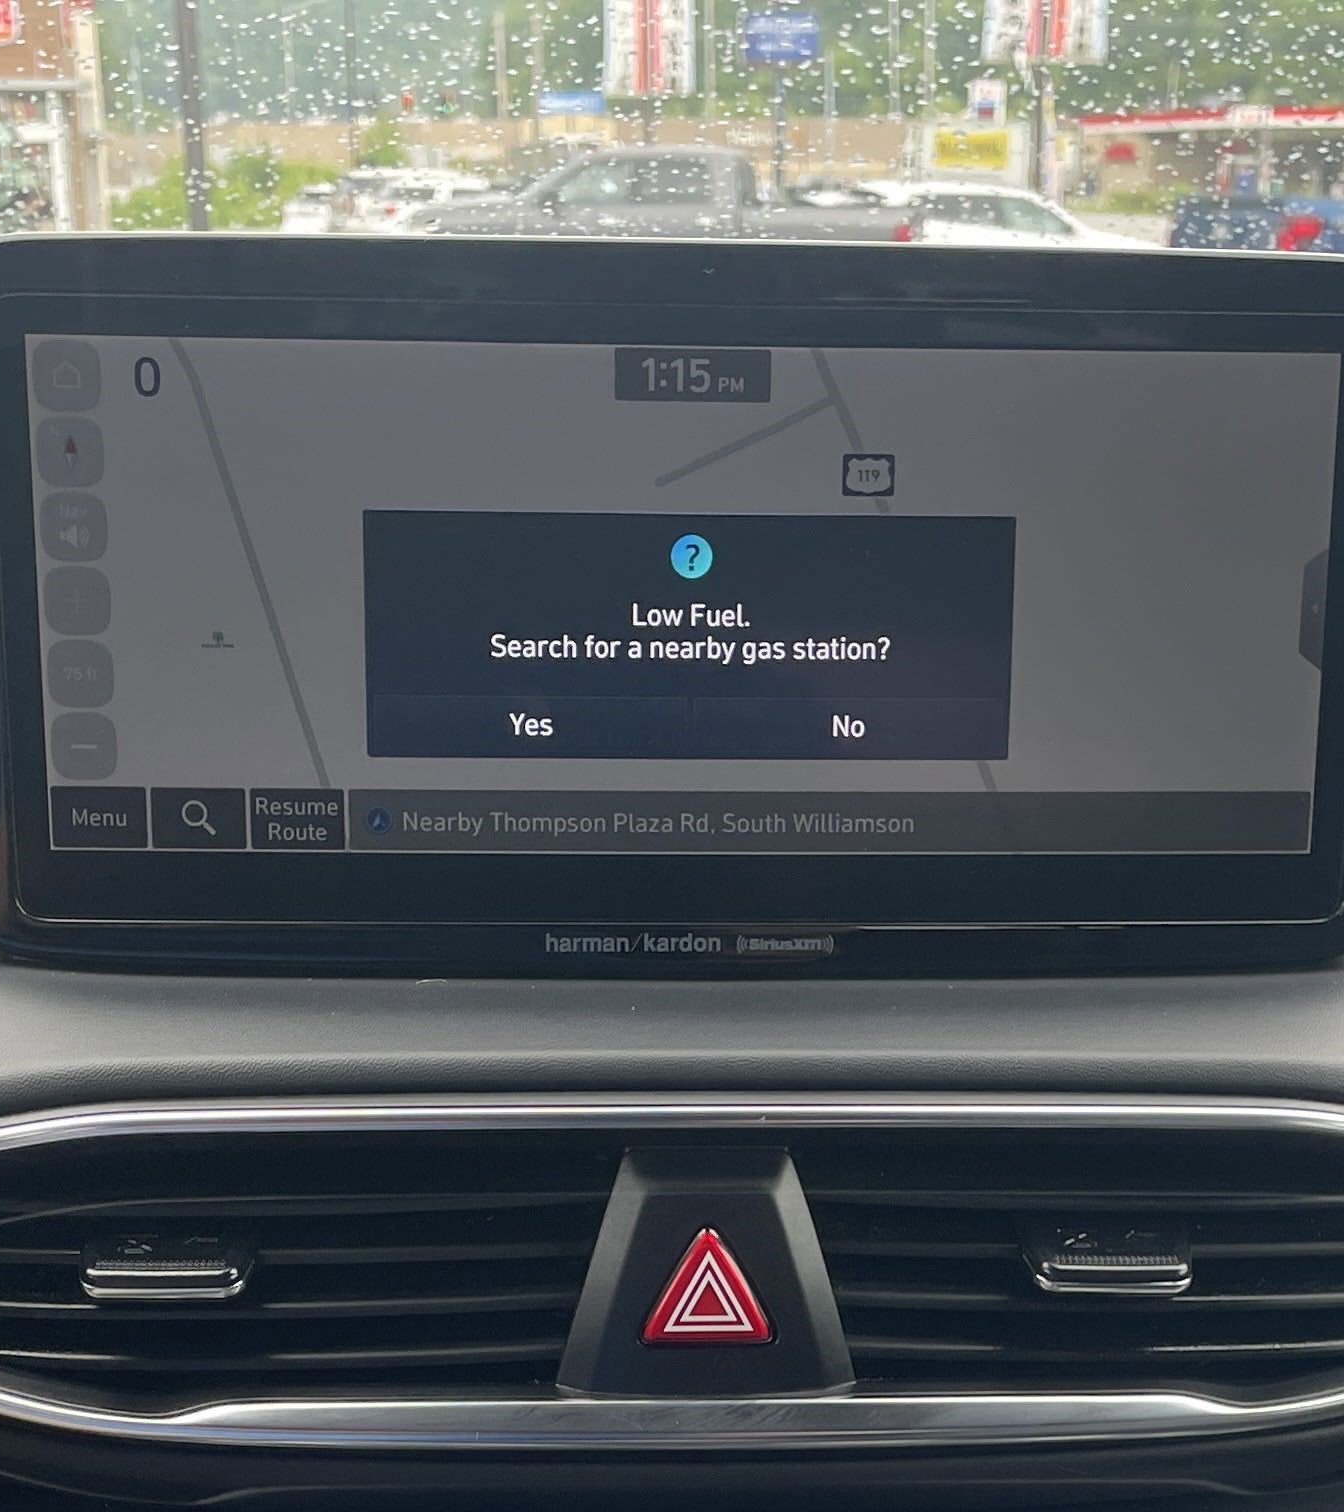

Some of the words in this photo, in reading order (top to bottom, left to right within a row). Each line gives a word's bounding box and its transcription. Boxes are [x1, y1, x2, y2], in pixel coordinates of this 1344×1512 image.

[134, 356, 161, 397] 0
[641, 357, 712, 394] 1:15
[718, 376, 745, 393] PM
[857, 469, 880, 484] 119
[632, 604, 684, 628] Low
[691, 603, 750, 628] Fuel.
[490, 633, 577, 660] Search
[584, 634, 622, 660] for
[628, 641, 642, 660] a
[649, 635, 735, 665] nearby
[742, 641, 785, 666] gas
[793, 635, 890, 662] station?
[509, 712, 553, 737] Yes
[832, 714, 866, 739] No
[71, 807, 128, 828] Menu
[256, 797, 338, 817] Resume
[267, 822, 327, 842] Route
[402, 811, 483, 837] Nearby
[490, 812, 606, 837] Thompson
[613, 813, 673, 835] Plaza
[722, 813, 786, 836] South
[793, 813, 915, 836] Williamson
